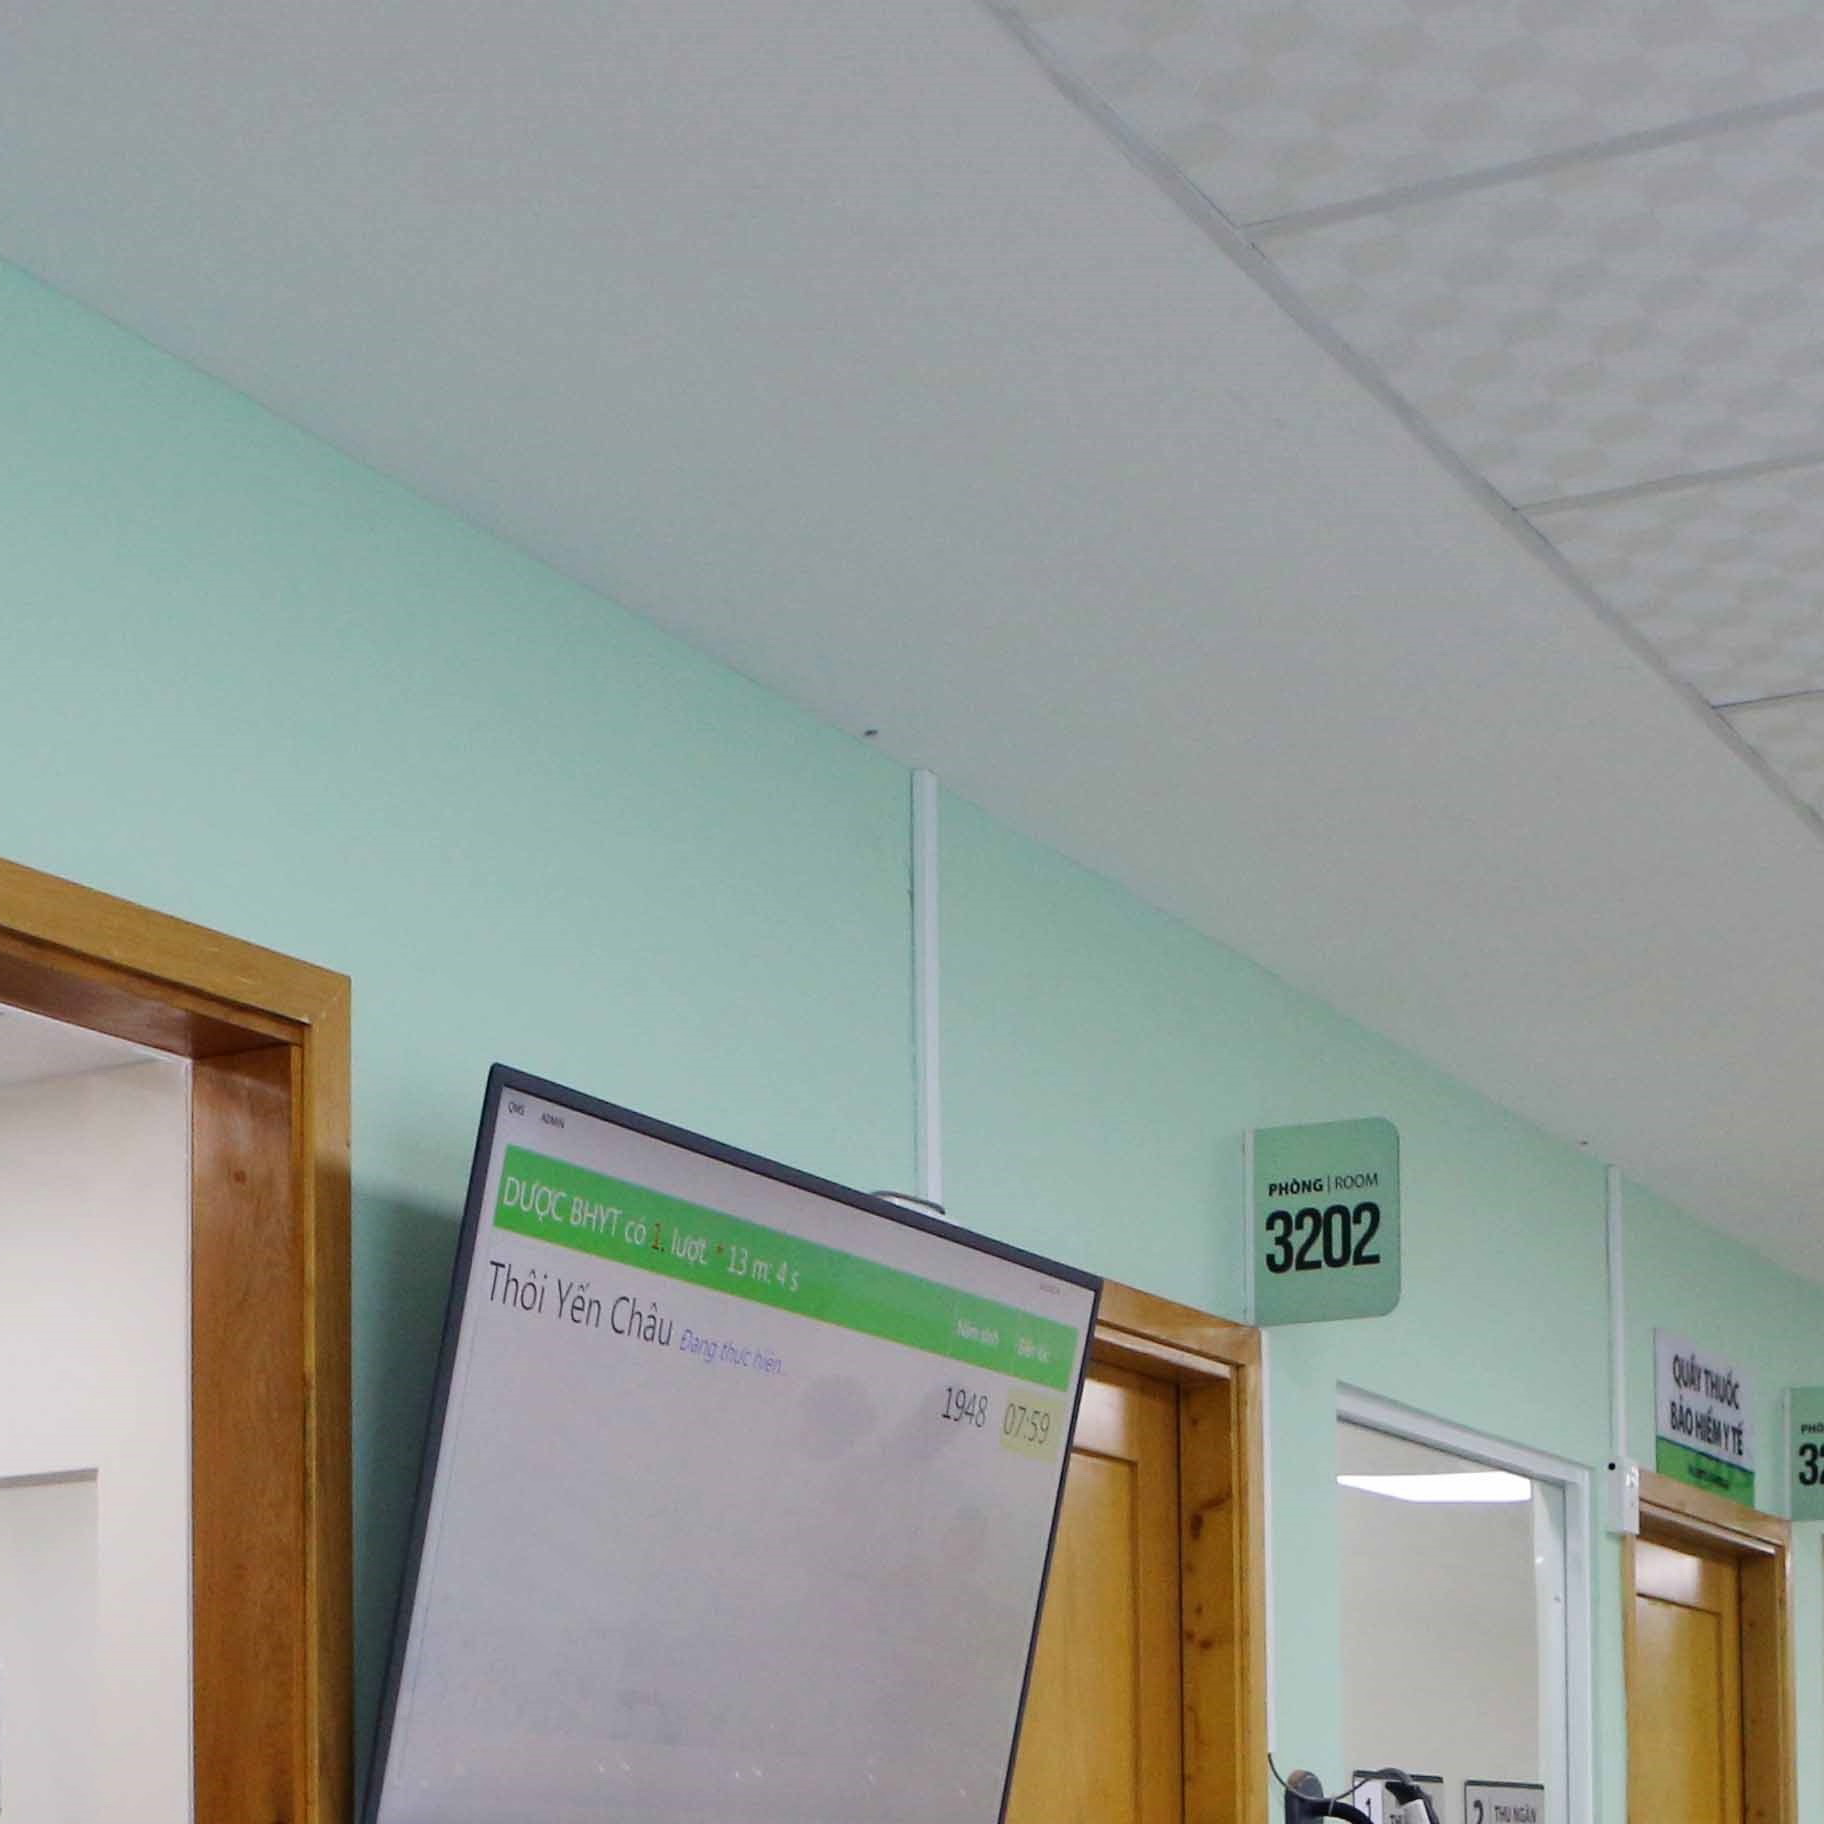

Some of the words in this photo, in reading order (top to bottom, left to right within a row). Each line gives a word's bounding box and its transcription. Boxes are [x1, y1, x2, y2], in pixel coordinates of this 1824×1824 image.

[1268, 1178, 1324, 1197] PHÒNG
[1335, 1173, 1379, 1190] ROOM
[569, 1196, 623, 1237] BHYT
[625, 1216, 647, 1245] có
[1265, 1202, 1380, 1274] 3202
[489, 1260, 547, 1313] Thôi
[558, 1279, 601, 1328] Yến
[611, 1296, 674, 1347] Châu
[942, 1387, 989, 1428] 1948
[1003, 1403, 1051, 1445] 07:59
[1704, 1369, 1740, 1410] THUỐC
[1670, 1395, 1693, 1437] BẢO
[1723, 1423, 1730, 1450] Y
